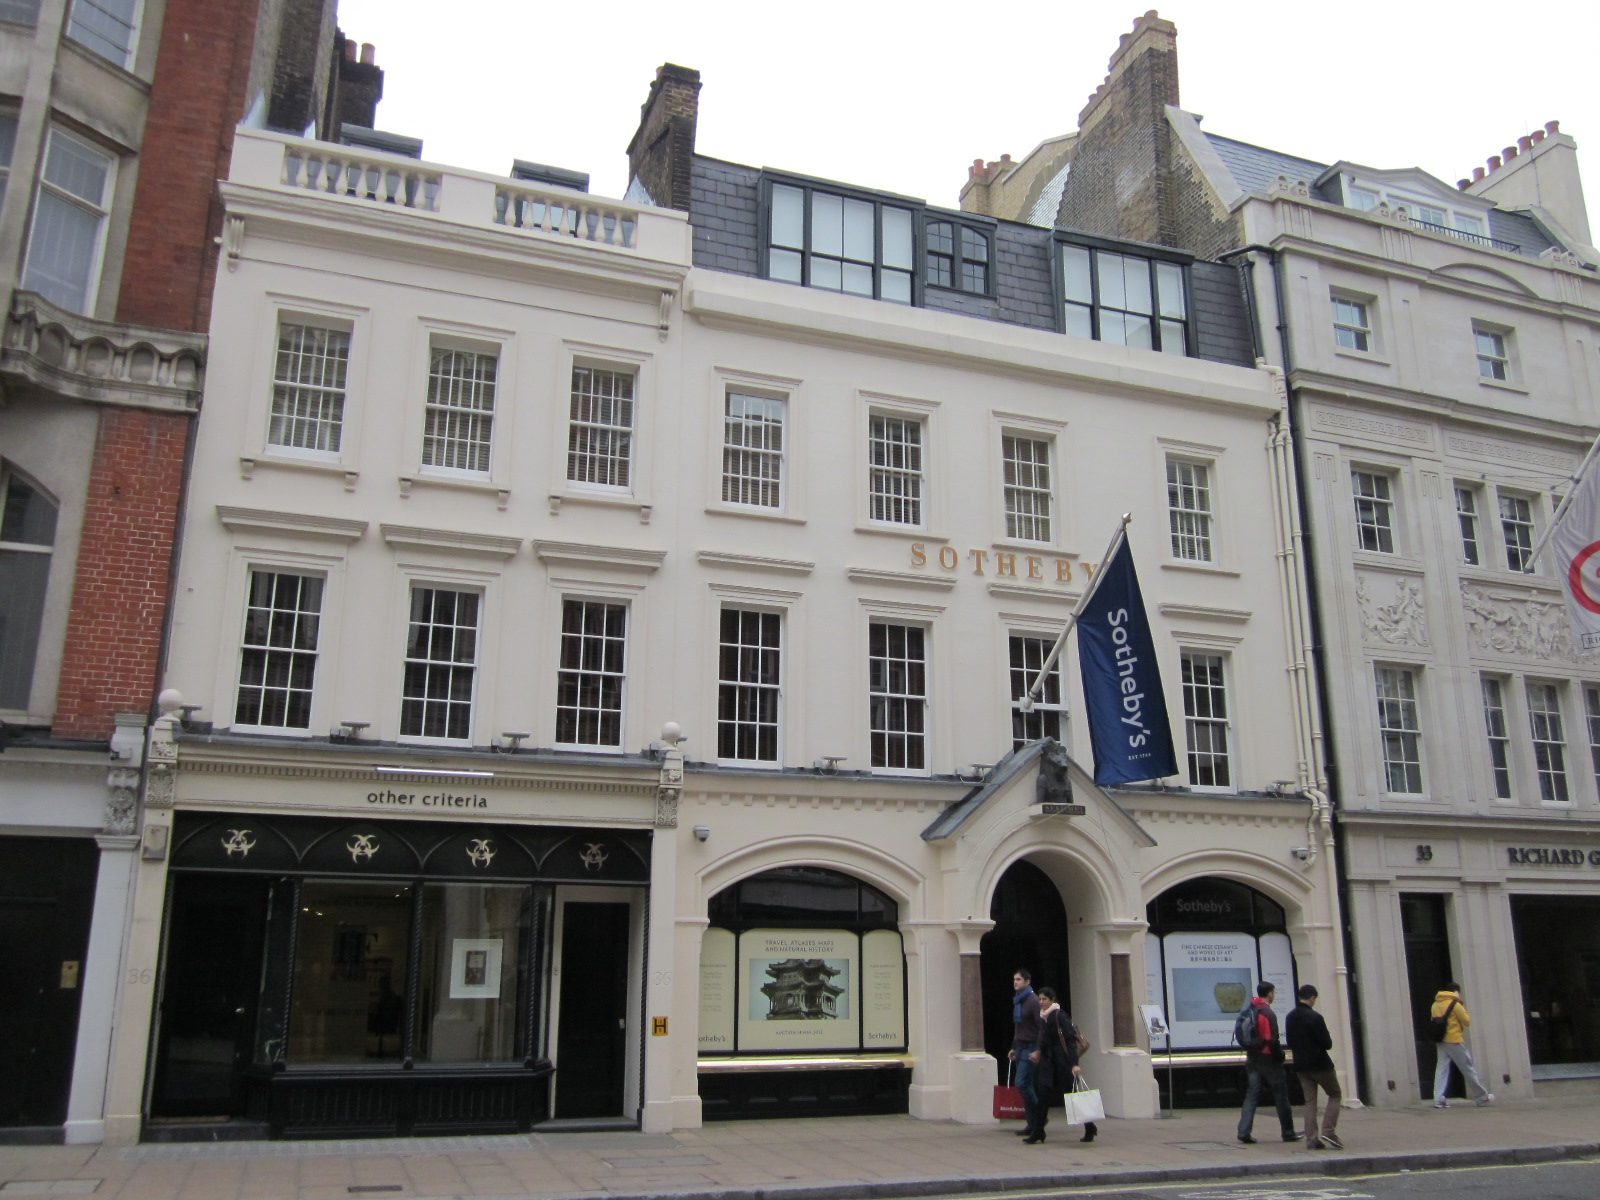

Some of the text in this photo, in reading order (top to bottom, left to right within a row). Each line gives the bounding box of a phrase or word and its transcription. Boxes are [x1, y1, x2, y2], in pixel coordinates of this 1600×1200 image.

[1587, 636, 1600, 645] RI
[1107, 608, 1151, 748] Sotheby's
[367, 790, 488, 808] other criteria
[1416, 844, 1433, 862] 33
[1507, 847, 1585, 866] RICHARD
[1176, 898, 1232, 915] Sotheby's
[128, 967, 151, 985] 36
[698, 1034, 726, 1043] otheby's
[868, 1031, 897, 1041] Sotheby's
